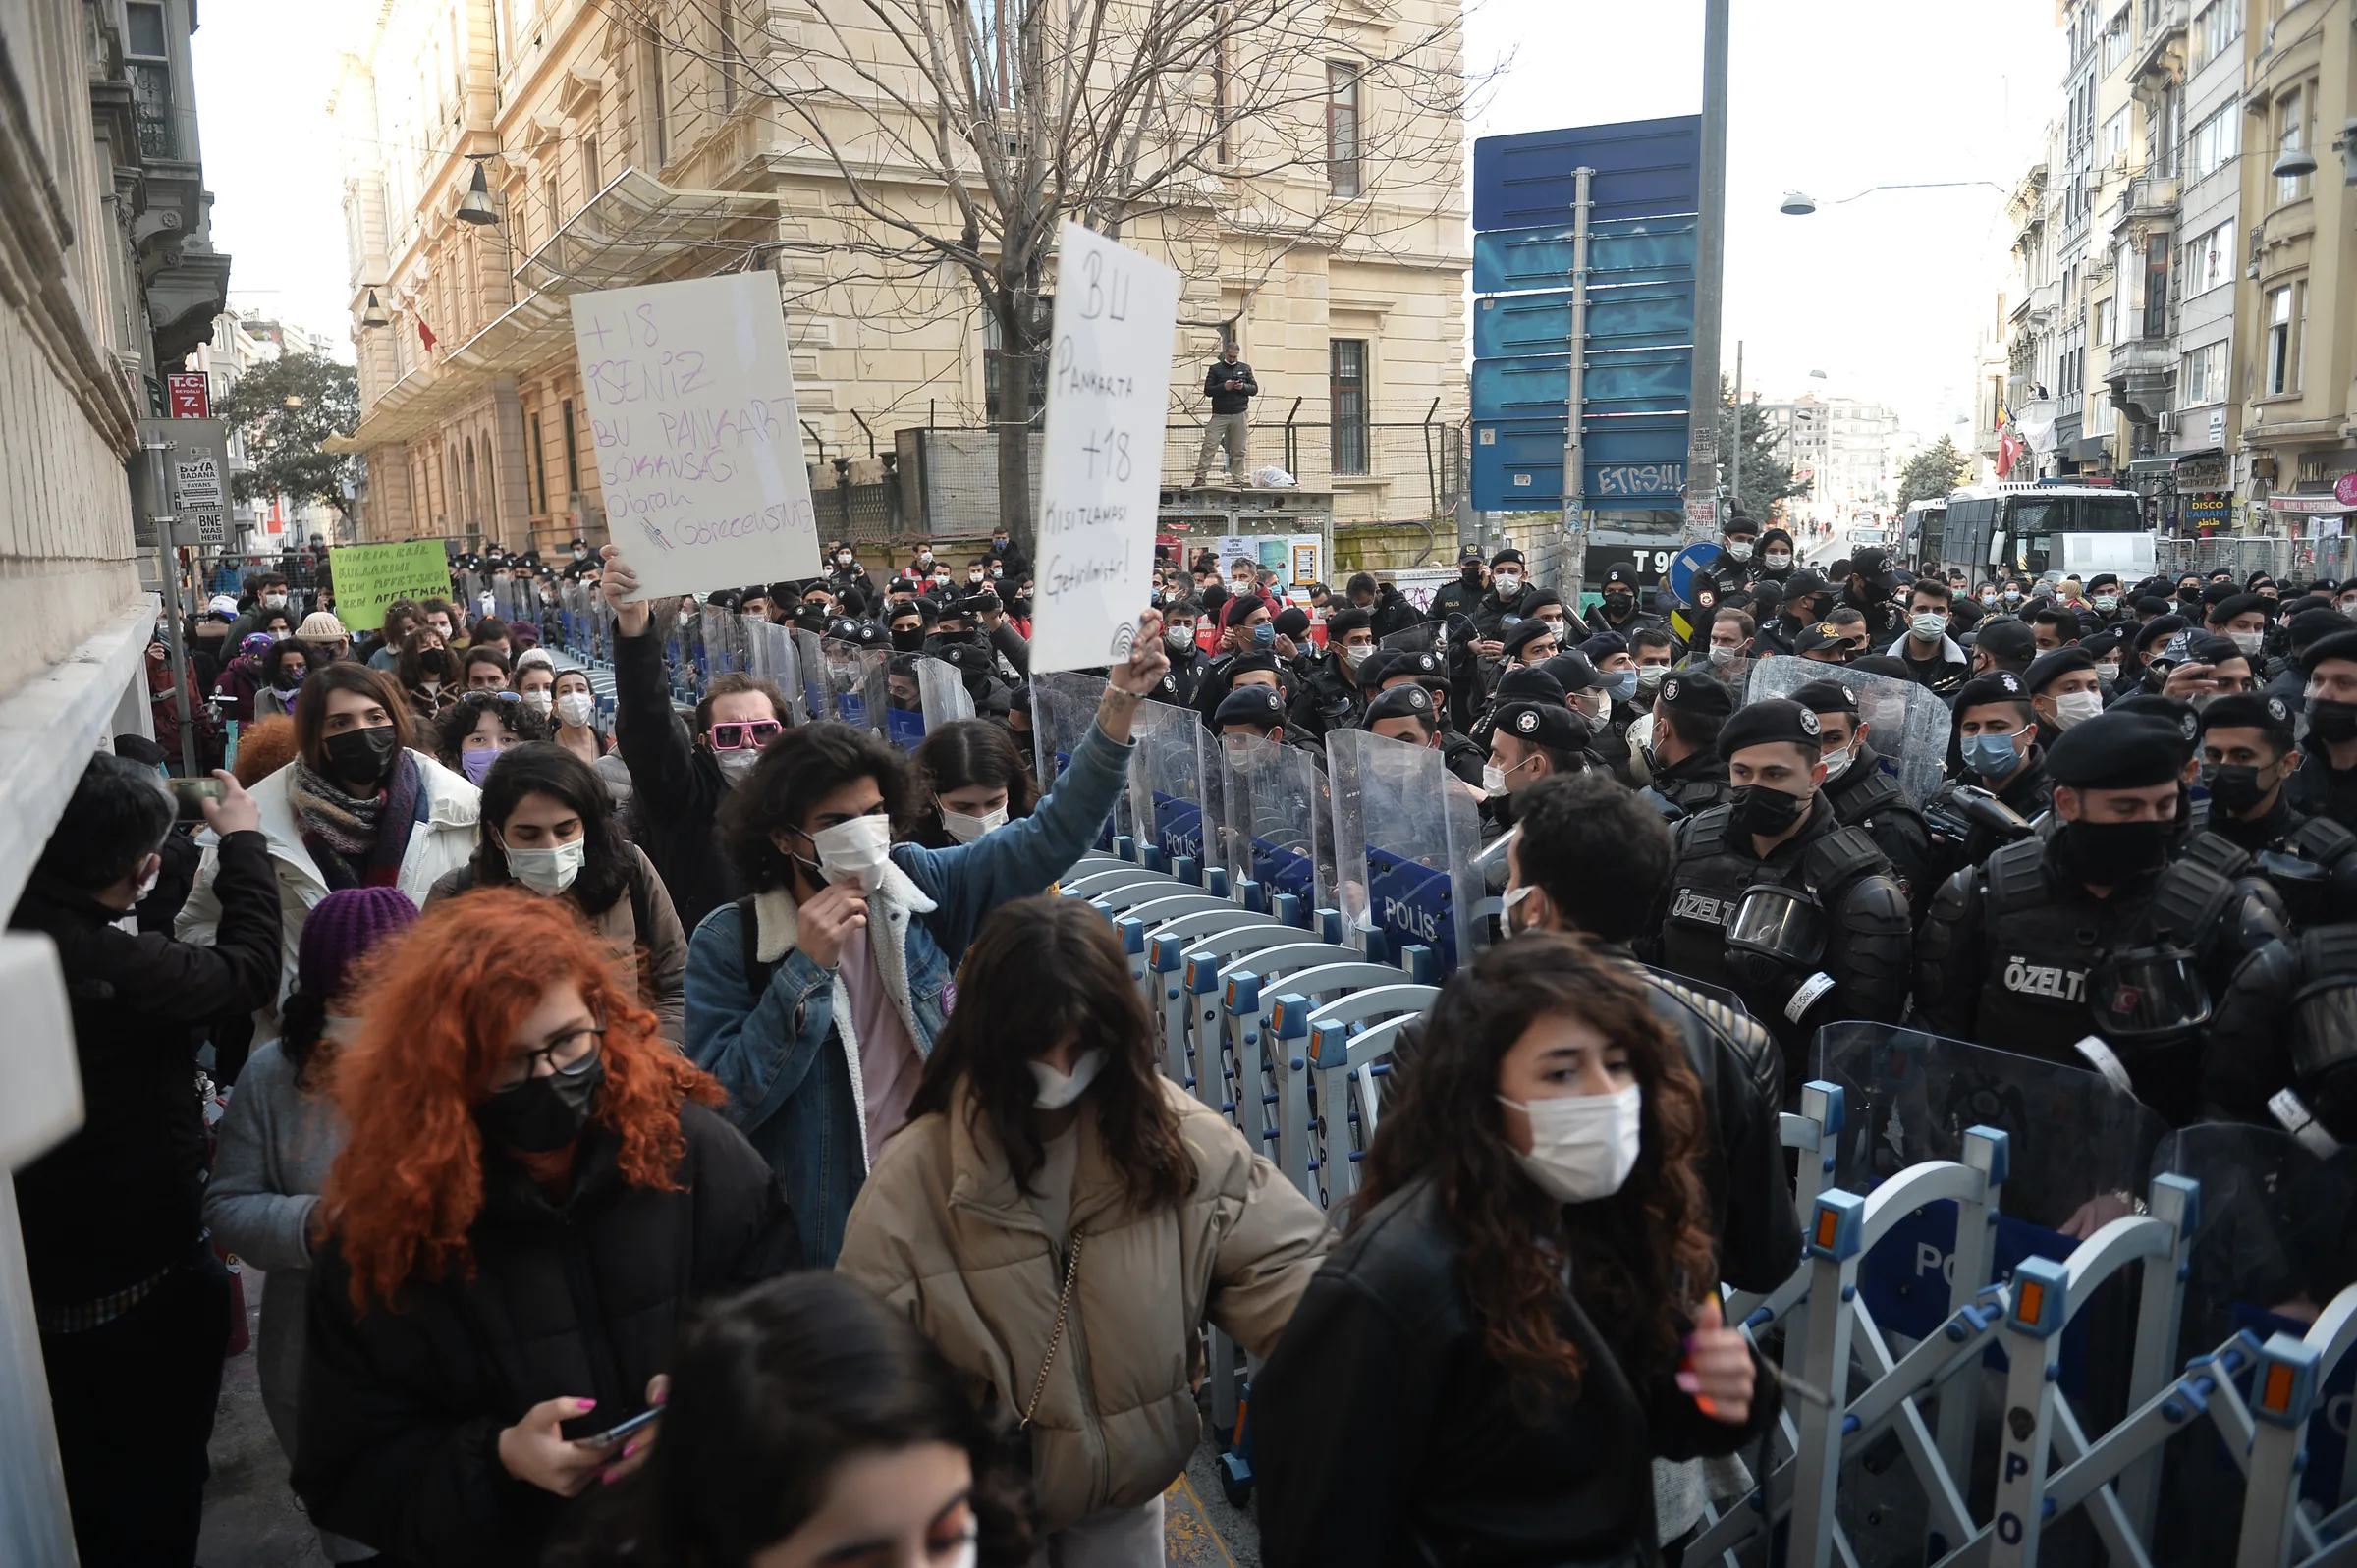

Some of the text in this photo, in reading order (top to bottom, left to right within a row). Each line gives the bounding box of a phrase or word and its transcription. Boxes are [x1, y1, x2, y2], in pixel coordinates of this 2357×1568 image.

[581, 303, 658, 350] +18
[170, 377, 204, 388] T.C.
[180, 397, 199, 407] 7.
[592, 416, 630, 448] BU
[1082, 427, 1132, 482] +18
[2186, 510, 2229, 518] L'AMANT
[2192, 501, 2224, 510] DISCO
[199, 514, 222, 527] BNE
[1633, 550, 1649, 572] T
[374, 585, 449, 604] AFFETMEM
[1166, 831, 1196, 860] POLİS
[1385, 896, 1436, 942] POLİS
